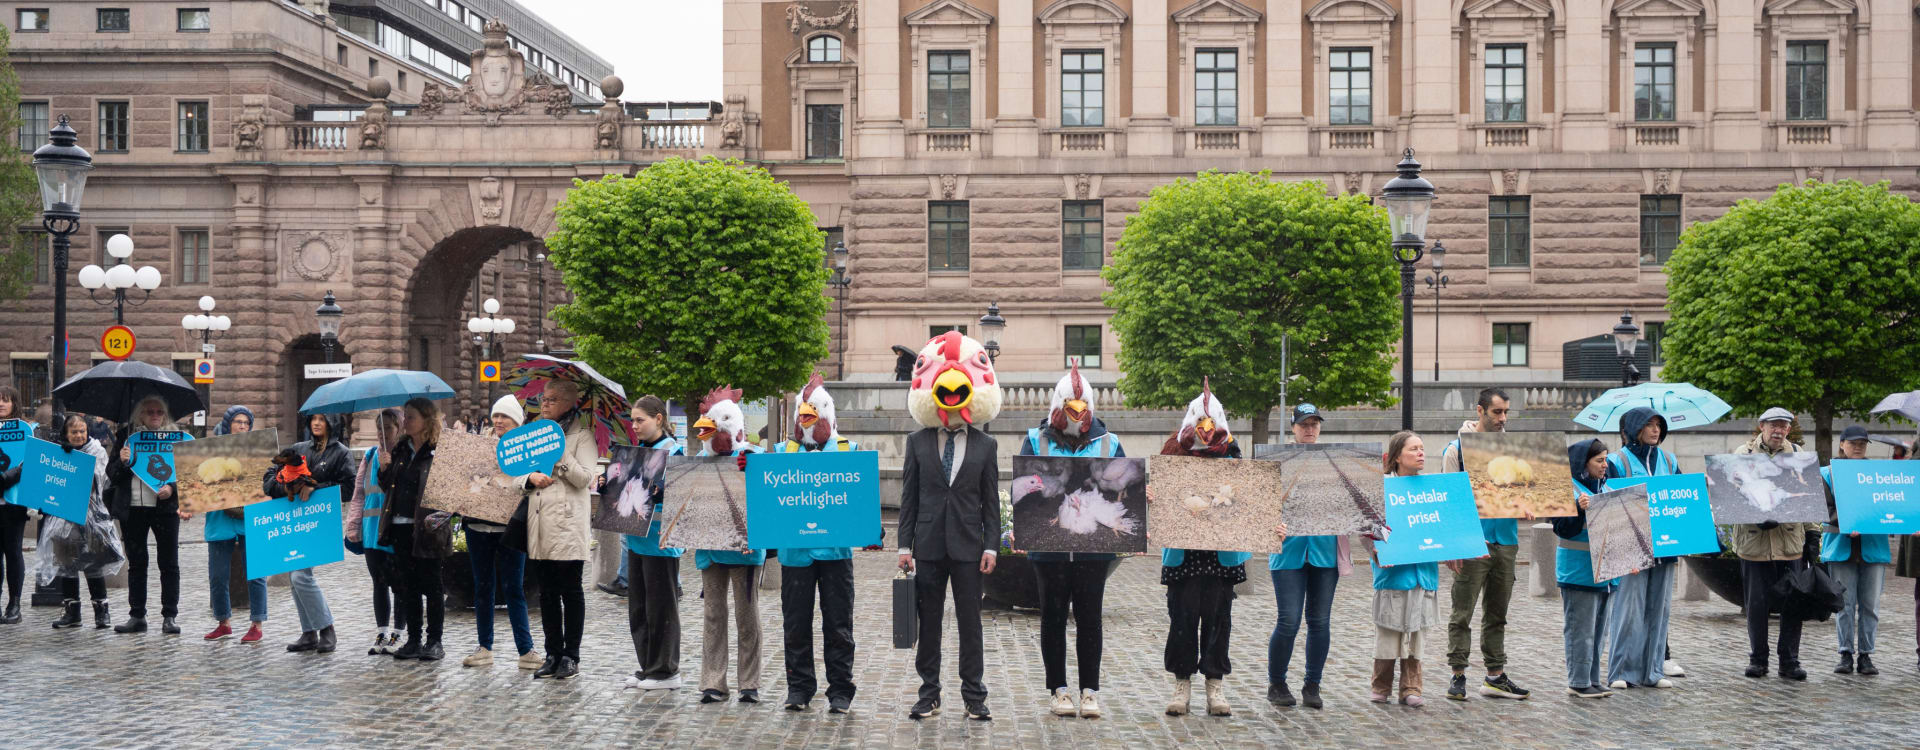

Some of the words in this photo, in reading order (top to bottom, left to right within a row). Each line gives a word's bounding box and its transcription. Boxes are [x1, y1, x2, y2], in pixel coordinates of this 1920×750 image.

[109, 340, 120, 348] 12
[124, 339, 128, 348] t
[142, 432, 180, 440] FRIENDS
[503, 425, 553, 447] KYCKLINGAR
[136, 443, 154, 451] NOT
[504, 454, 523, 466] INTE
[530, 441, 560, 457] MAGEN
[505, 444, 524, 457] MITT
[40, 453, 50, 467] De
[52, 456, 78, 473] betalar
[45, 474, 66, 488] priset
[764, 469, 860, 488] Kycklingarnas
[1857, 472, 1873, 484] De
[1875, 472, 1915, 484] betalar
[778, 491, 848, 510] verklighet
[1389, 493, 1406, 506] De
[1407, 489, 1448, 504] betalar
[1658, 489, 1669, 500] till
[1872, 490, 1905, 504] priset
[254, 516, 272, 527] Från
[292, 506, 303, 518] till
[1408, 510, 1440, 528] priset
[1649, 507, 1660, 517] 35
[1662, 505, 1687, 518] dagar
[268, 527, 279, 540] på
[281, 524, 292, 536] 35
[294, 520, 319, 533] dagar
